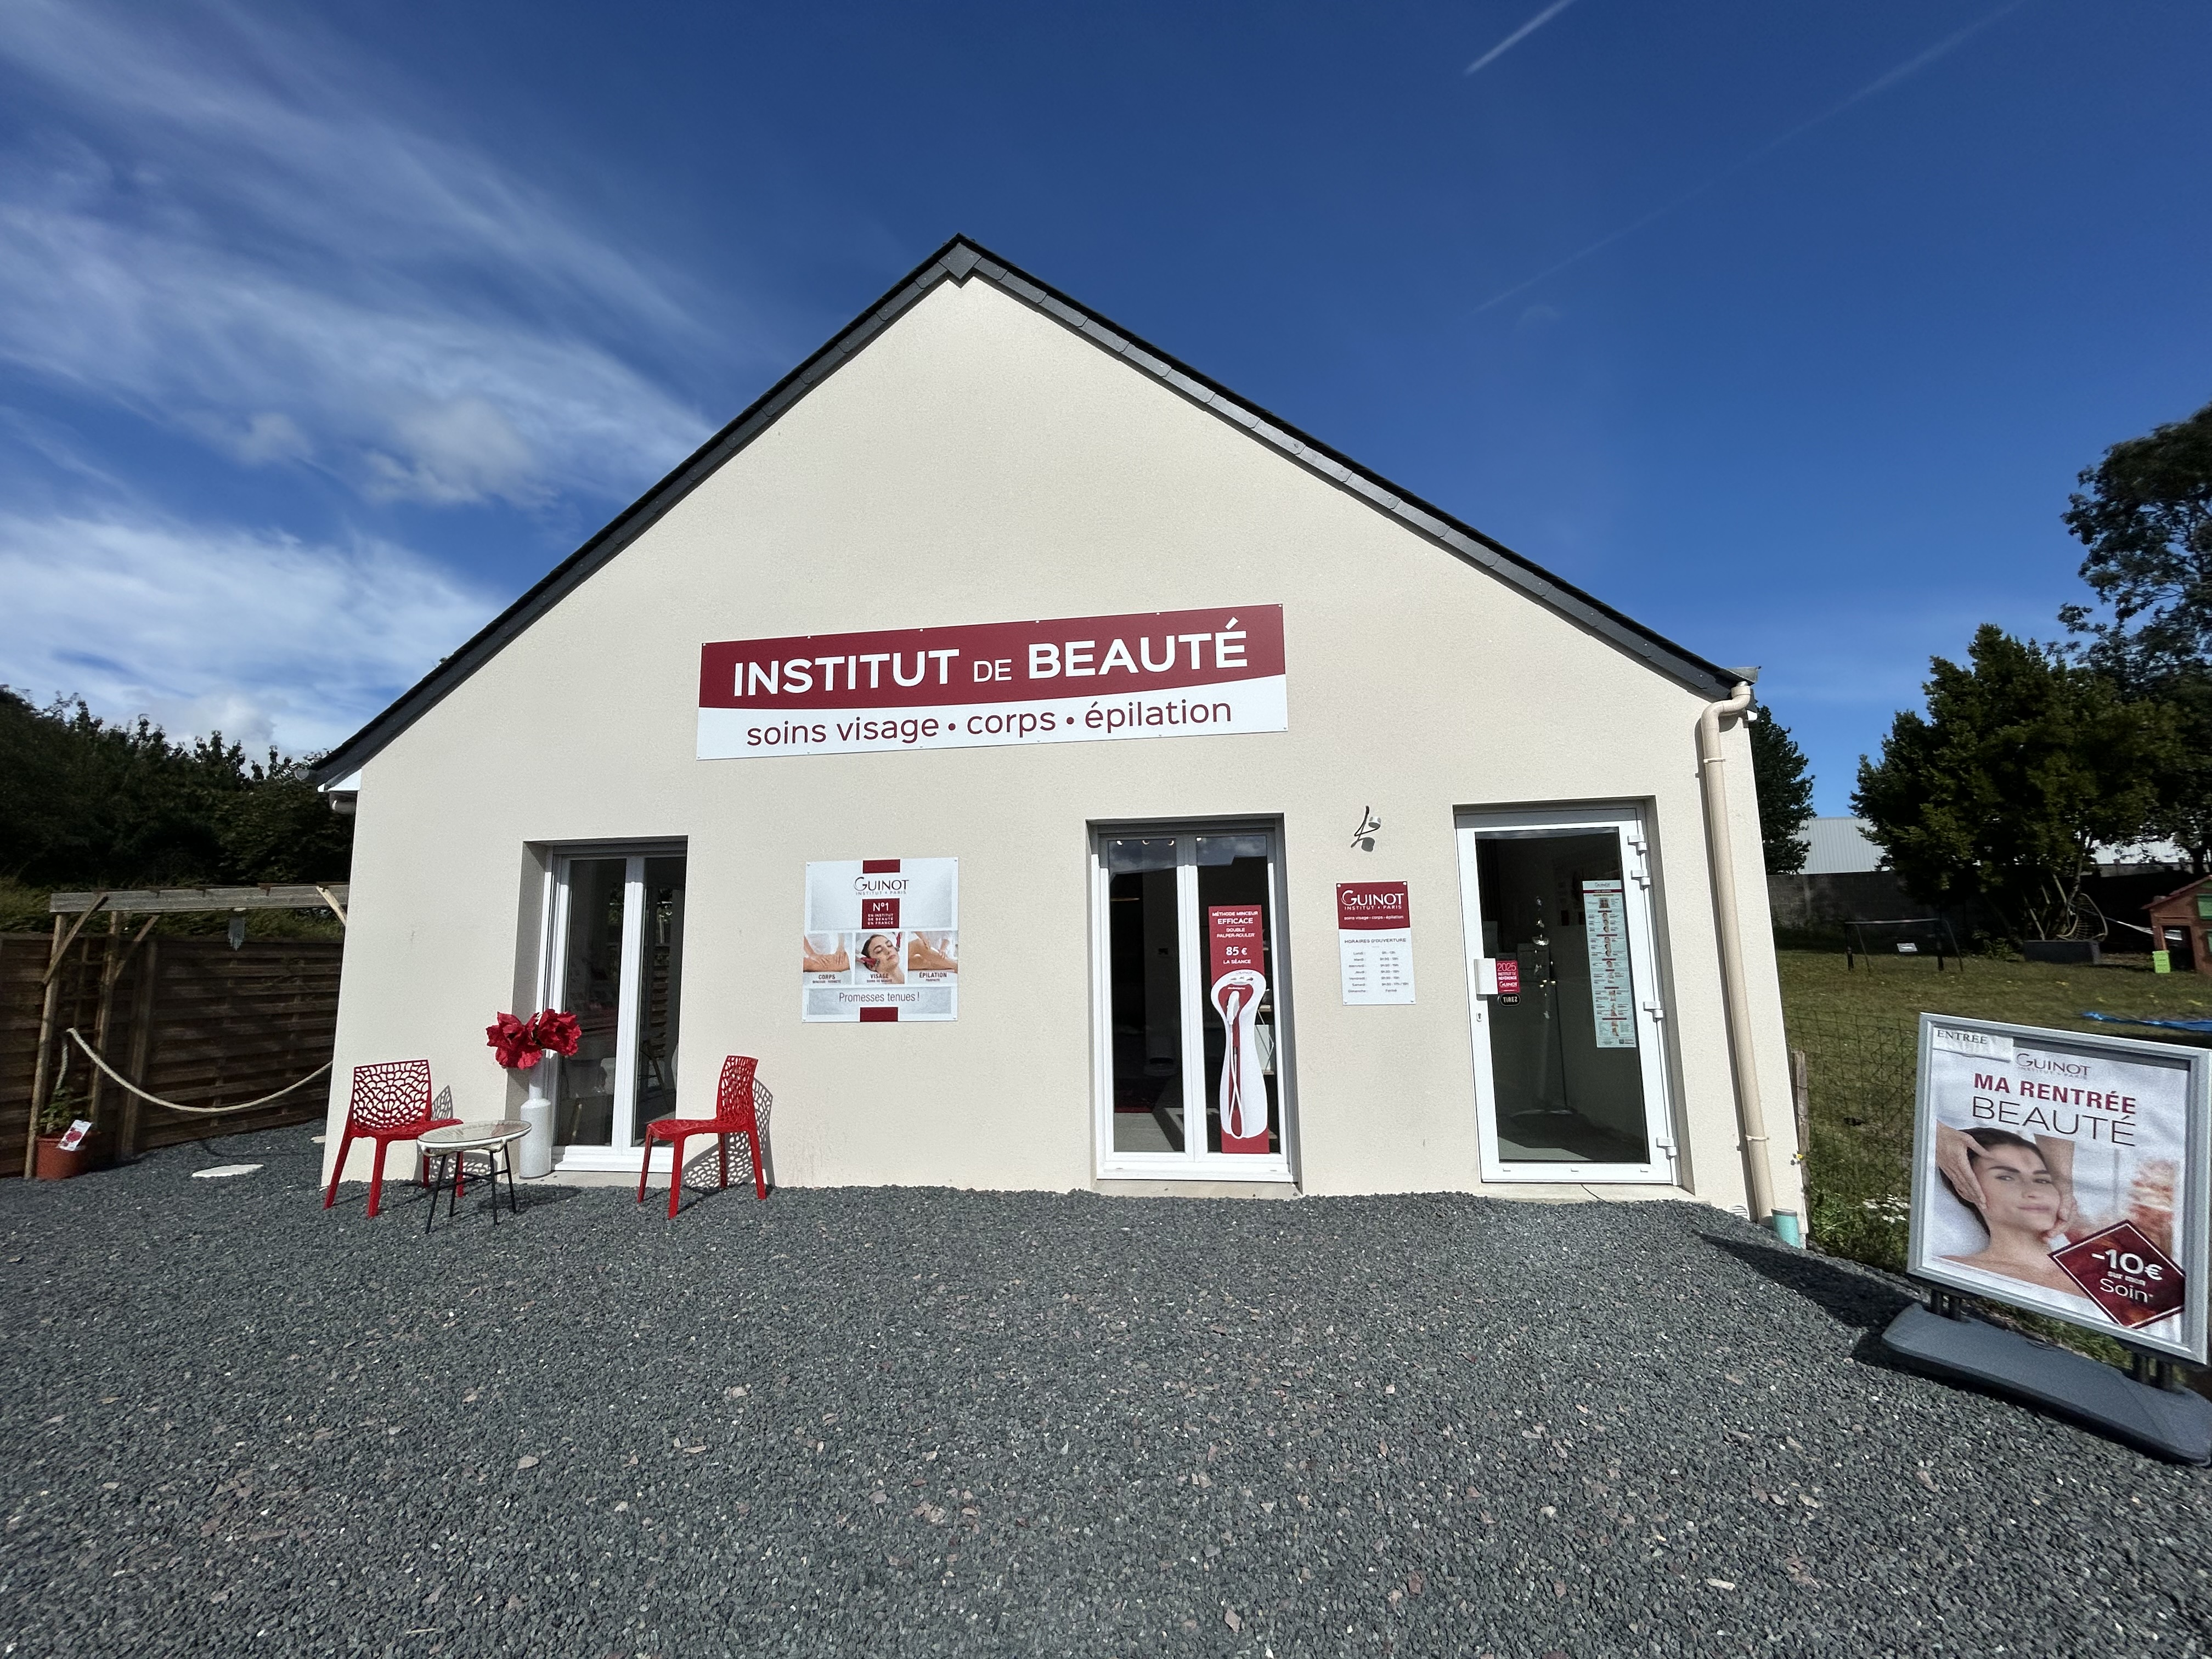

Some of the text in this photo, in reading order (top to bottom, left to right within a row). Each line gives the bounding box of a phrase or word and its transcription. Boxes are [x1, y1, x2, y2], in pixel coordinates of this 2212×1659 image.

[734, 617, 1248, 697] INSTITUT DE BEAUTÉ
[747, 698, 1232, 746] soins visage corps épilation
[853, 876, 910, 891] GUINOT
[1340, 890, 1404, 906] GUINOT
[1226, 946, 1239, 956] 85
[1497, 962, 1517, 972] 2025
[839, 991, 885, 1002] Promesses
[1937, 1029, 1988, 1045] ENTREE
[2015, 1053, 2091, 1076] GUINOT
[1974, 1073, 2136, 1115] MA RENTRÉE
[1972, 1096, 2136, 1147] BEAUTÉ
[2091, 1249, 2163, 1280] -10€
